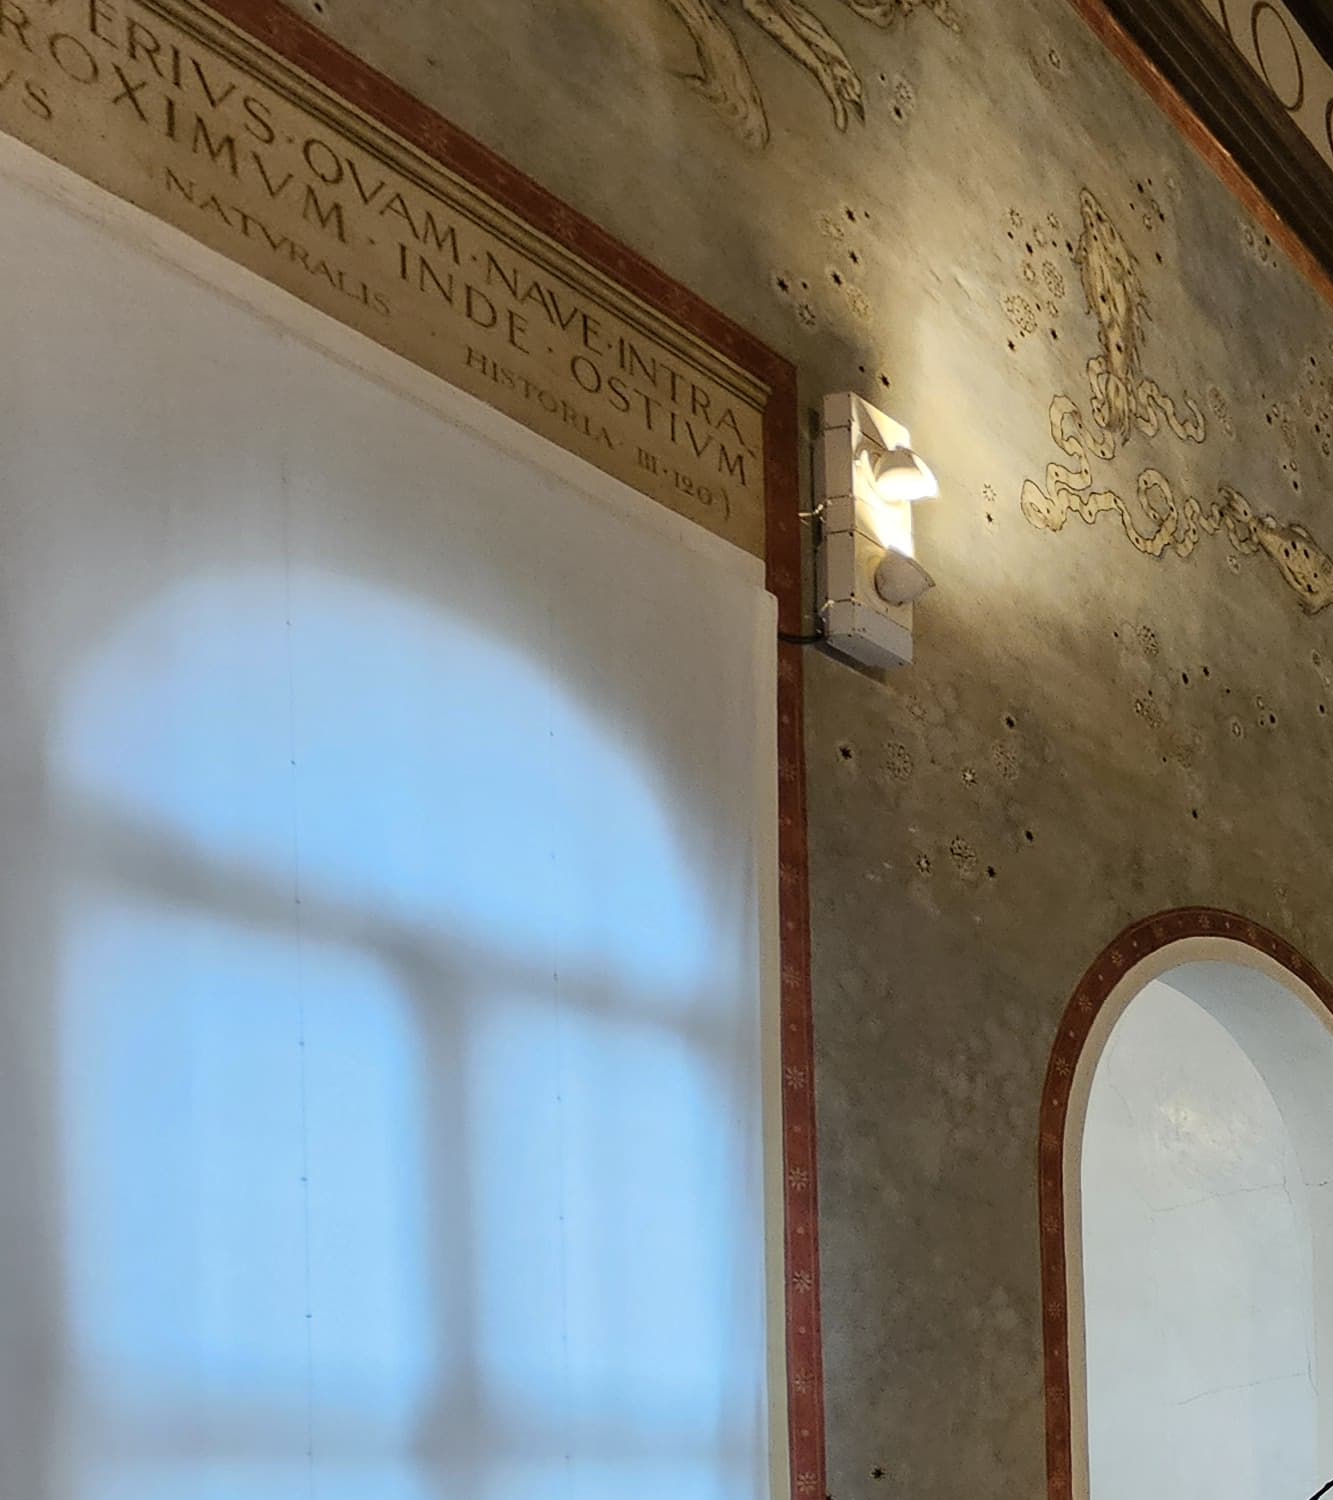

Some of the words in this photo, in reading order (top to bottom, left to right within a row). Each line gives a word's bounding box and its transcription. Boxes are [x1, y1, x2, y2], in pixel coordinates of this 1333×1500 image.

[398, 240, 530, 355] INDE
[570, 355, 747, 487] OSTIVM
[486, 250, 603, 355] NAVE
[617, 335, 747, 447] INTRA
